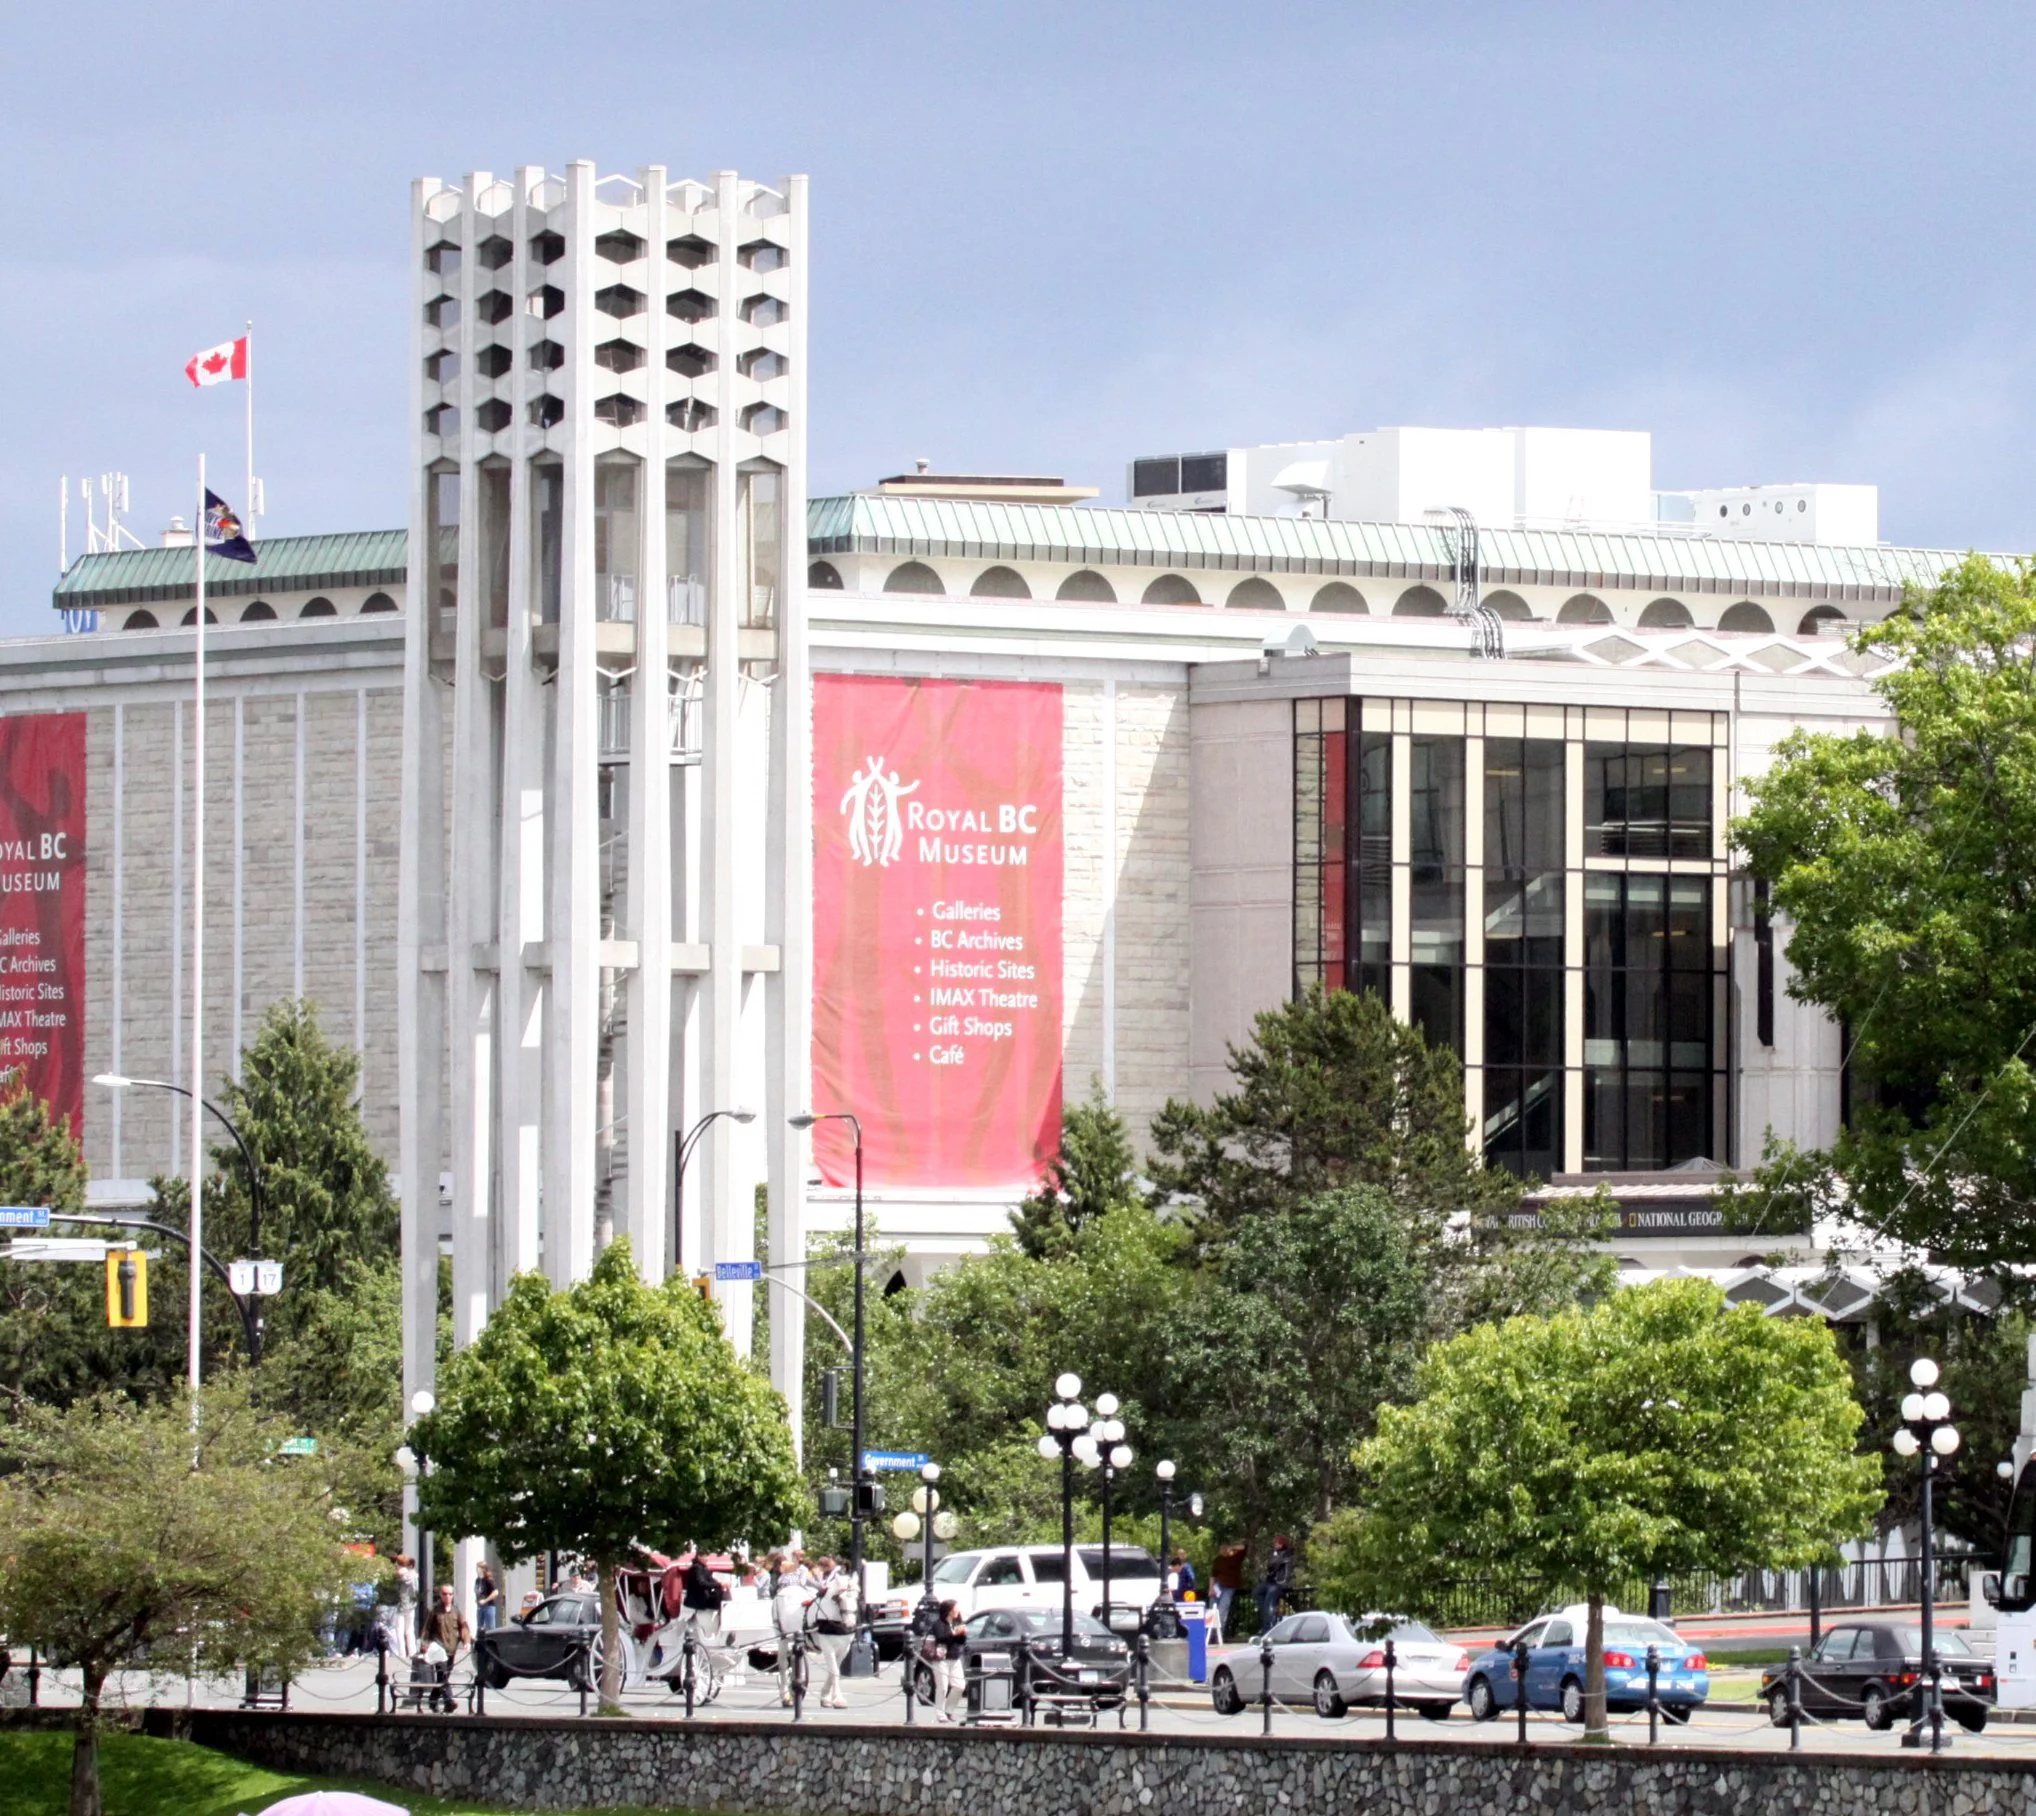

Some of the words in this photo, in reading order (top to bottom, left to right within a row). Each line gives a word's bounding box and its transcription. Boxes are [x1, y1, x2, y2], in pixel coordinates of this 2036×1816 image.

[998, 804, 1037, 834] BC
[41, 831, 67, 860] BC
[919, 836, 1027, 865] MUSEUM
[2, 871, 60, 893] USEUM
[932, 900, 1001, 922] Galleries
[930, 929, 953, 949] BC
[956, 929, 1024, 951] Archives
[10, 954, 57, 973] Archives
[930, 958, 994, 979] Historic
[997, 959, 1036, 980] Sites
[37, 982, 65, 1000] Sites
[930, 987, 975, 1007] IMAX
[979, 987, 1038, 1009] Theatre
[24, 1009, 67, 1027] Theatre
[929, 1015, 960, 1036] Gift
[963, 1016, 1013, 1042] Shops
[14, 1036, 48, 1060] Shops
[929, 1044, 965, 1065] Café
[1637, 1212, 1687, 1227] NATIONAL
[263, 1273, 277, 1286] 17
